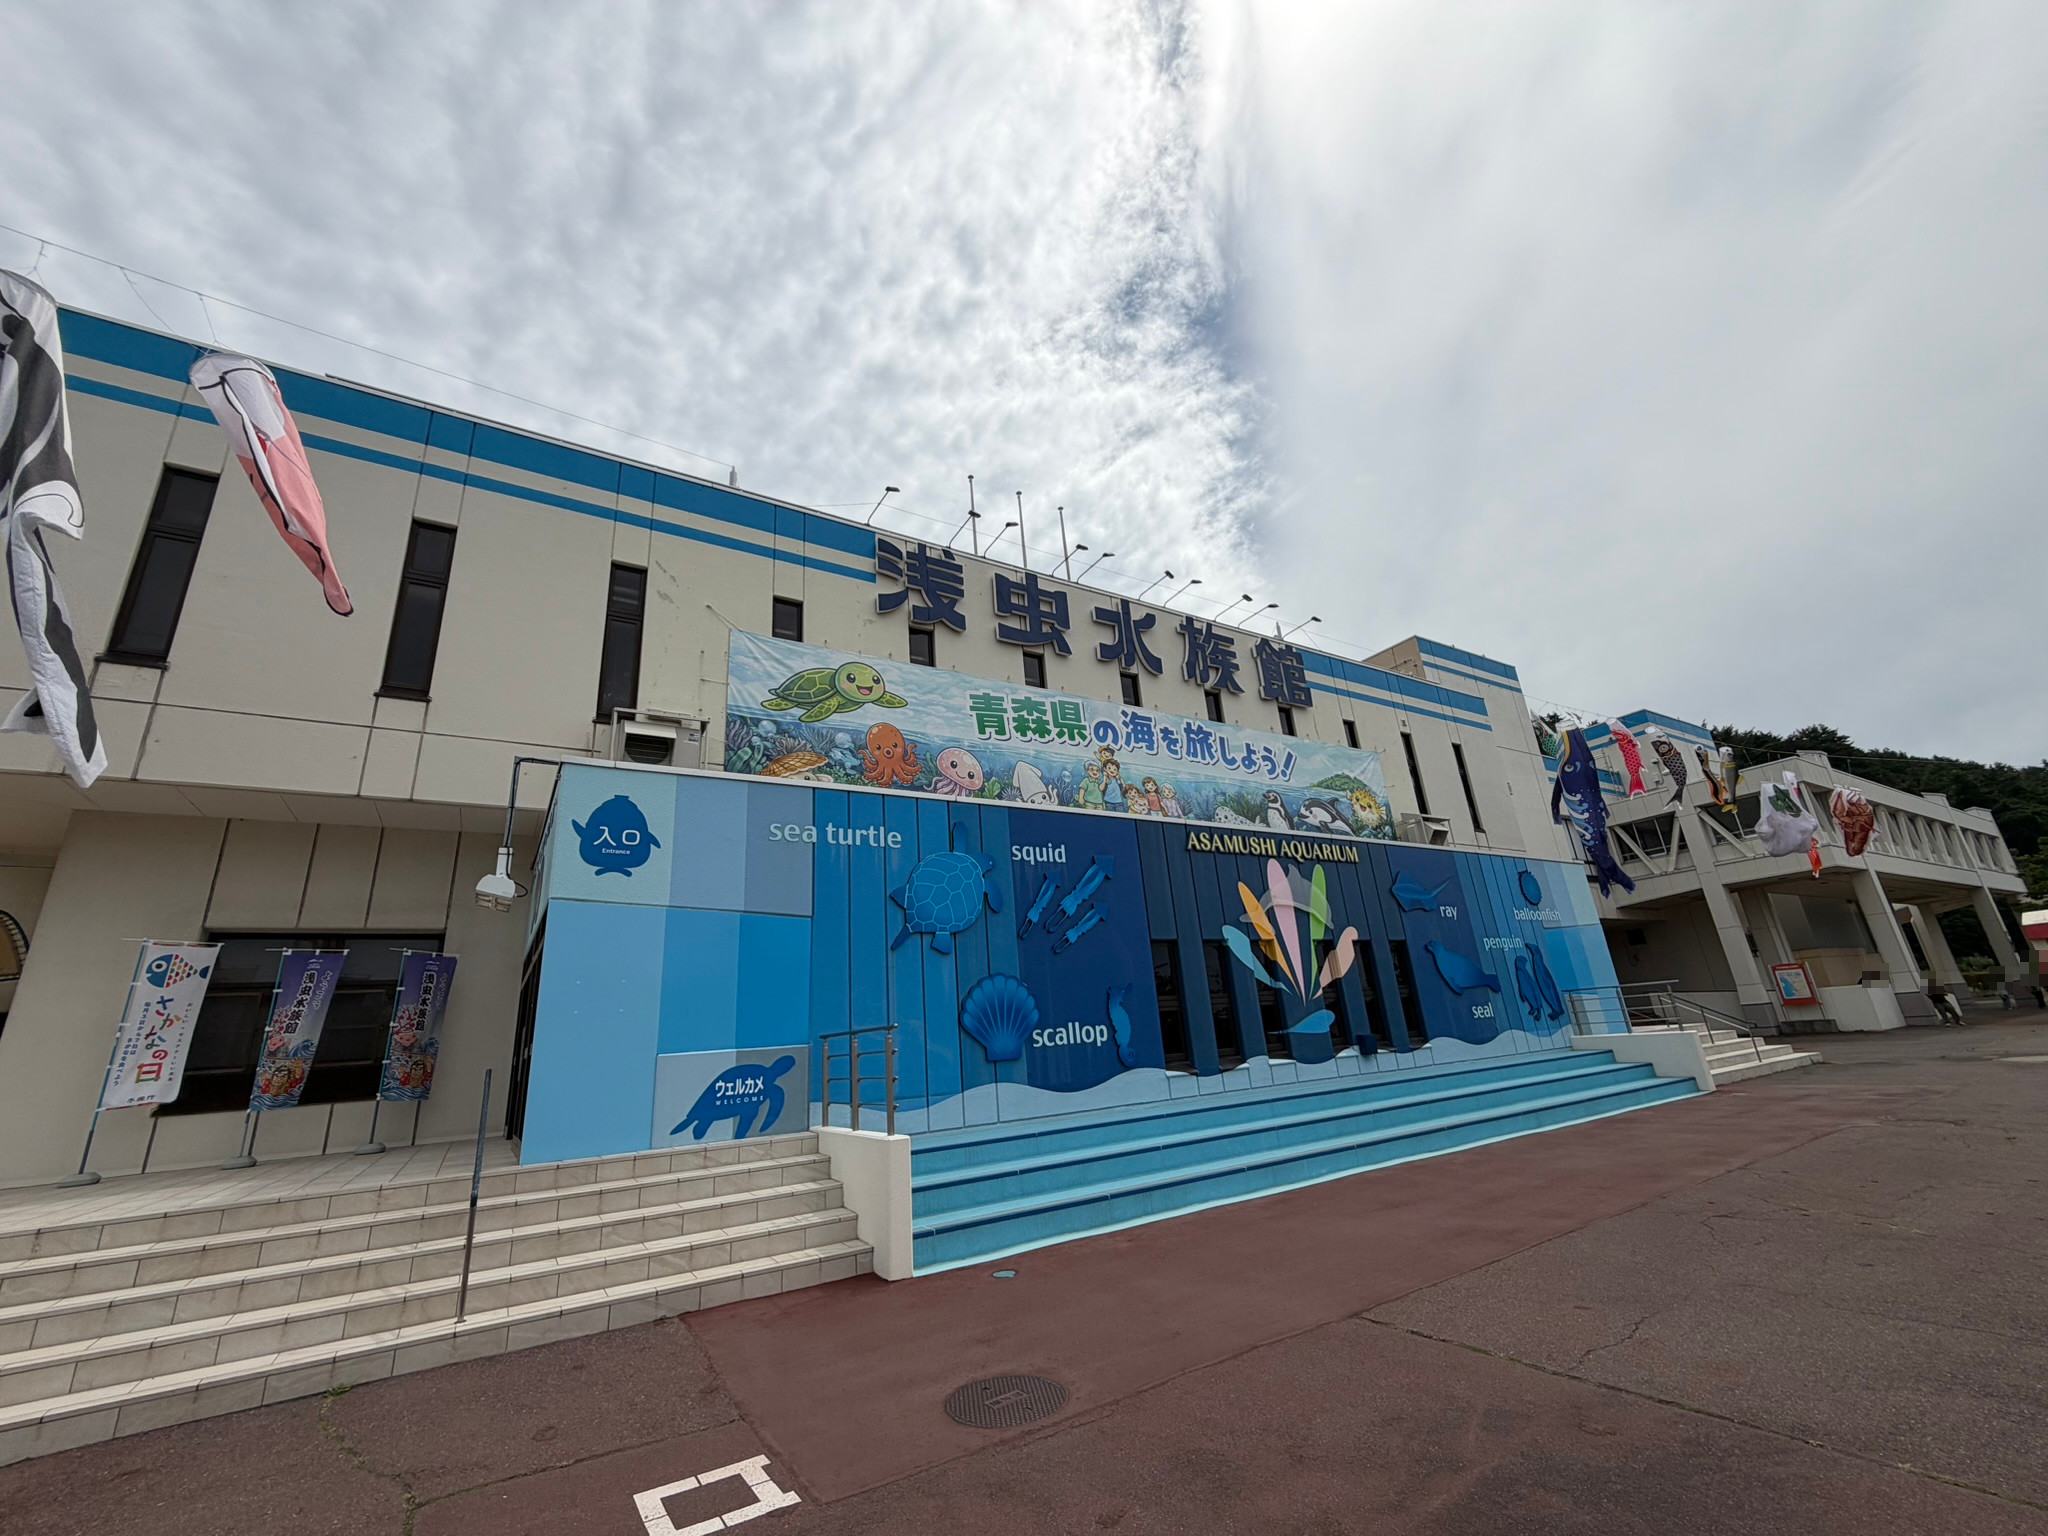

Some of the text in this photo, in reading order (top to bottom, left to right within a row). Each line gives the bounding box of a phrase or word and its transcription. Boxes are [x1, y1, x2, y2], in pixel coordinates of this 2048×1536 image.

[876, 537, 1314, 708] 浅虫水族館
[593, 826, 641, 846] 入口
[768, 822, 902, 848] sea turtle
[1011, 843, 1067, 865] squid
[1187, 832, 1359, 862] ASAMUSHI AQUARIUM
[1440, 906, 1457, 920] ray
[1513, 908, 1562, 921] balloonfish
[1483, 935, 1523, 951] penguin
[282, 970, 318, 1035] 浅虫水族館
[1472, 1002, 1494, 1018] seal
[135, 995, 182, 1084] さかなの日
[1032, 1022, 1109, 1048] scallop
[715, 1076, 764, 1097] ウェルカメ
[715, 1096, 764, 1105] WELCOME
